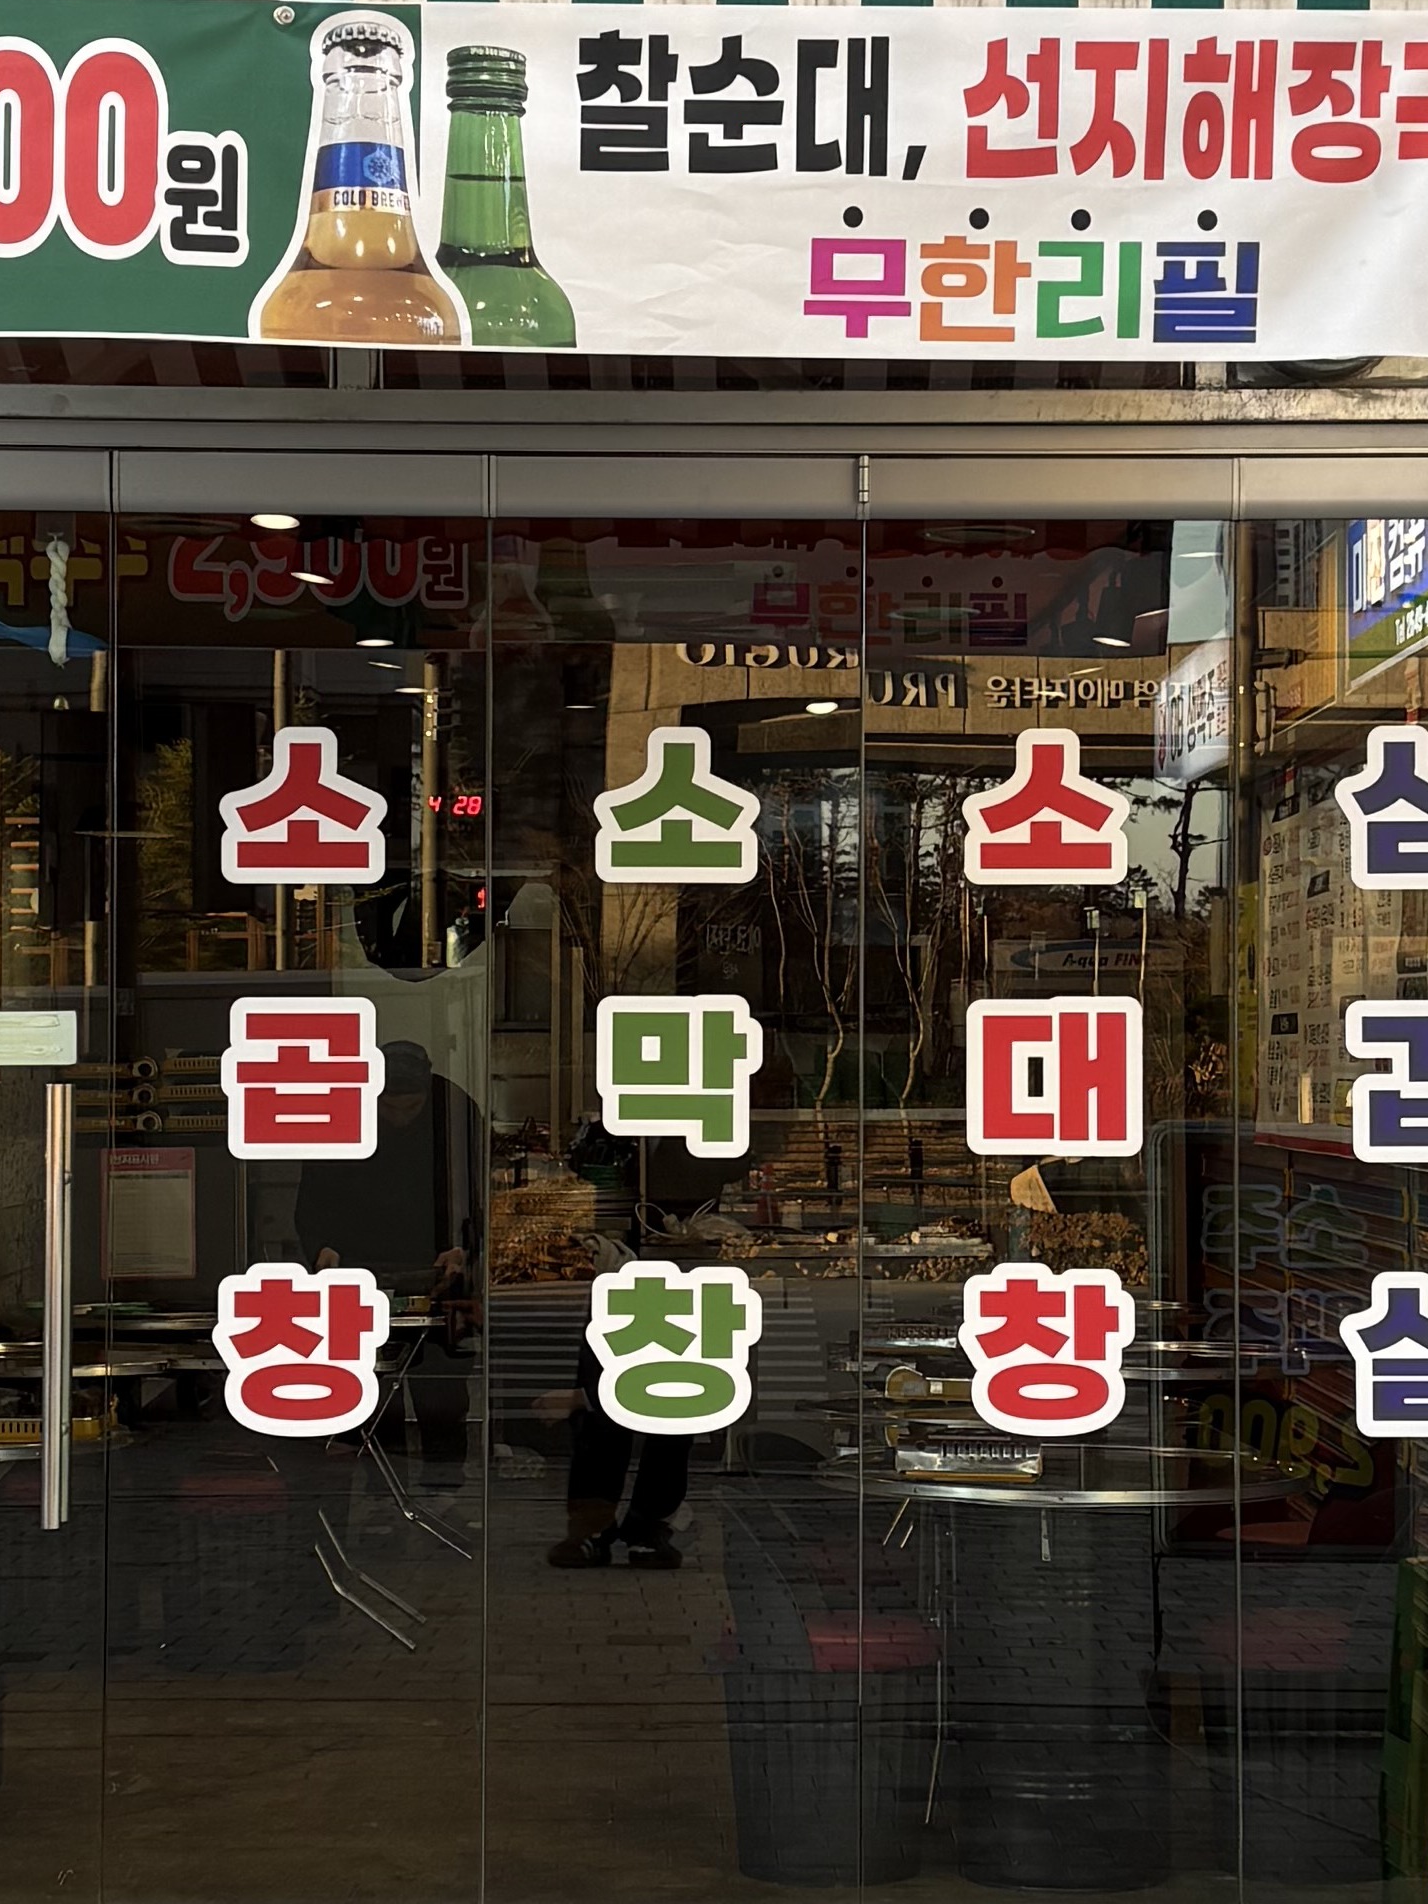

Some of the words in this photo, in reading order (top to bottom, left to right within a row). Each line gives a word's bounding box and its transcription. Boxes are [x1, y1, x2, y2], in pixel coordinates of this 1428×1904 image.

[576, 28, 927, 181] 찰순대,
[333, 188, 367, 208] COLD
[802, 235, 1260, 344] 무한리필
